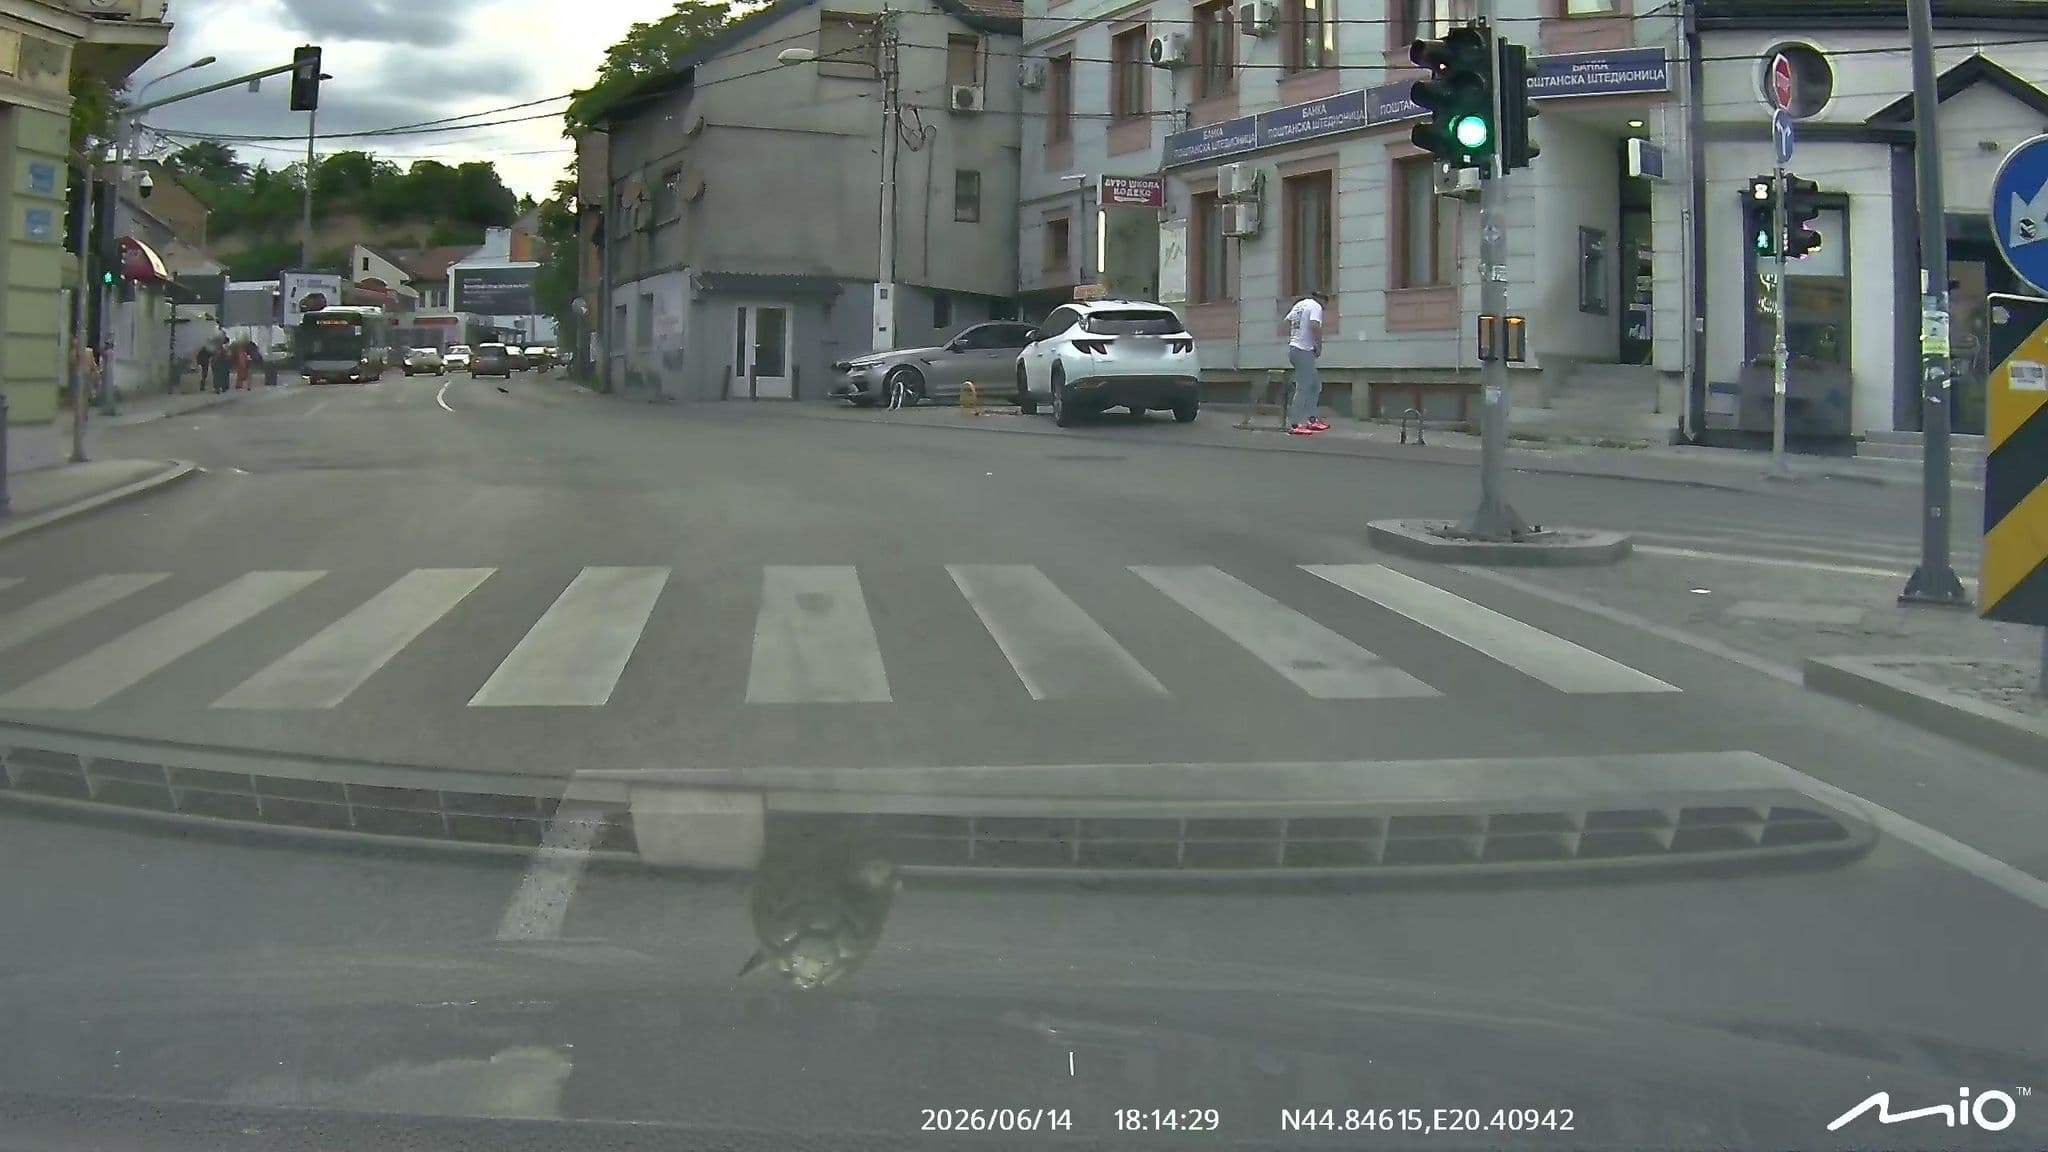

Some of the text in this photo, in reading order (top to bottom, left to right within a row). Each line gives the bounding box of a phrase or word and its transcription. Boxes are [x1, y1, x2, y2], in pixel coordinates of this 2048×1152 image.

[1526, 69, 1665, 88] ОШТАНСКА ШТЕДИОНИЦА
[1302, 104, 1328, 119] БАНКА
[1268, 110, 1365, 139] ПОШТАНСКА ШТЕДИОНИЦА
[1203, 128, 1224, 140] БАНКА
